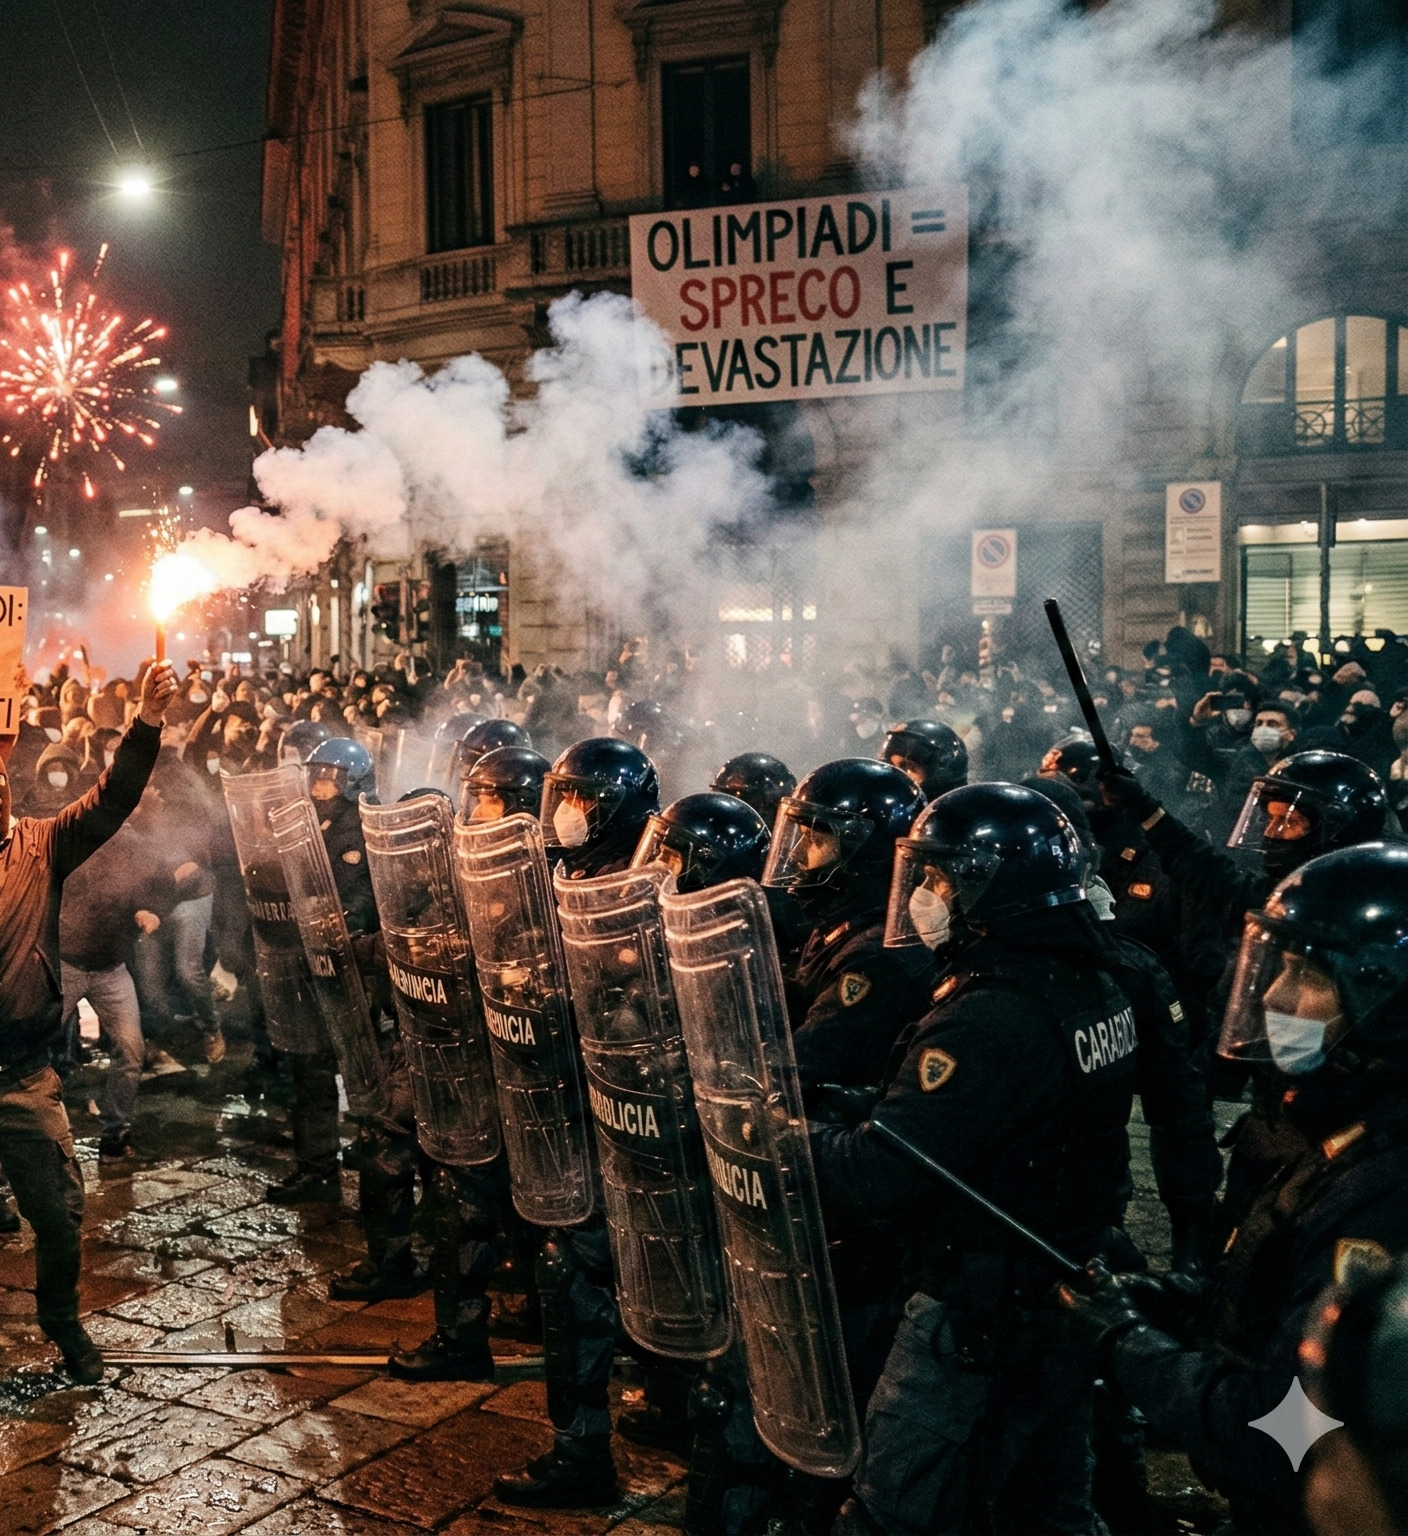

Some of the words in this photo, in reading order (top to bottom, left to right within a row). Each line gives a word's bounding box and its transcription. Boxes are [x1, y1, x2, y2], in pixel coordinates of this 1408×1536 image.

[647, 199, 891, 272] OLIMPIADI
[679, 265, 861, 332] SPRECO
[886, 260, 914, 315] E
